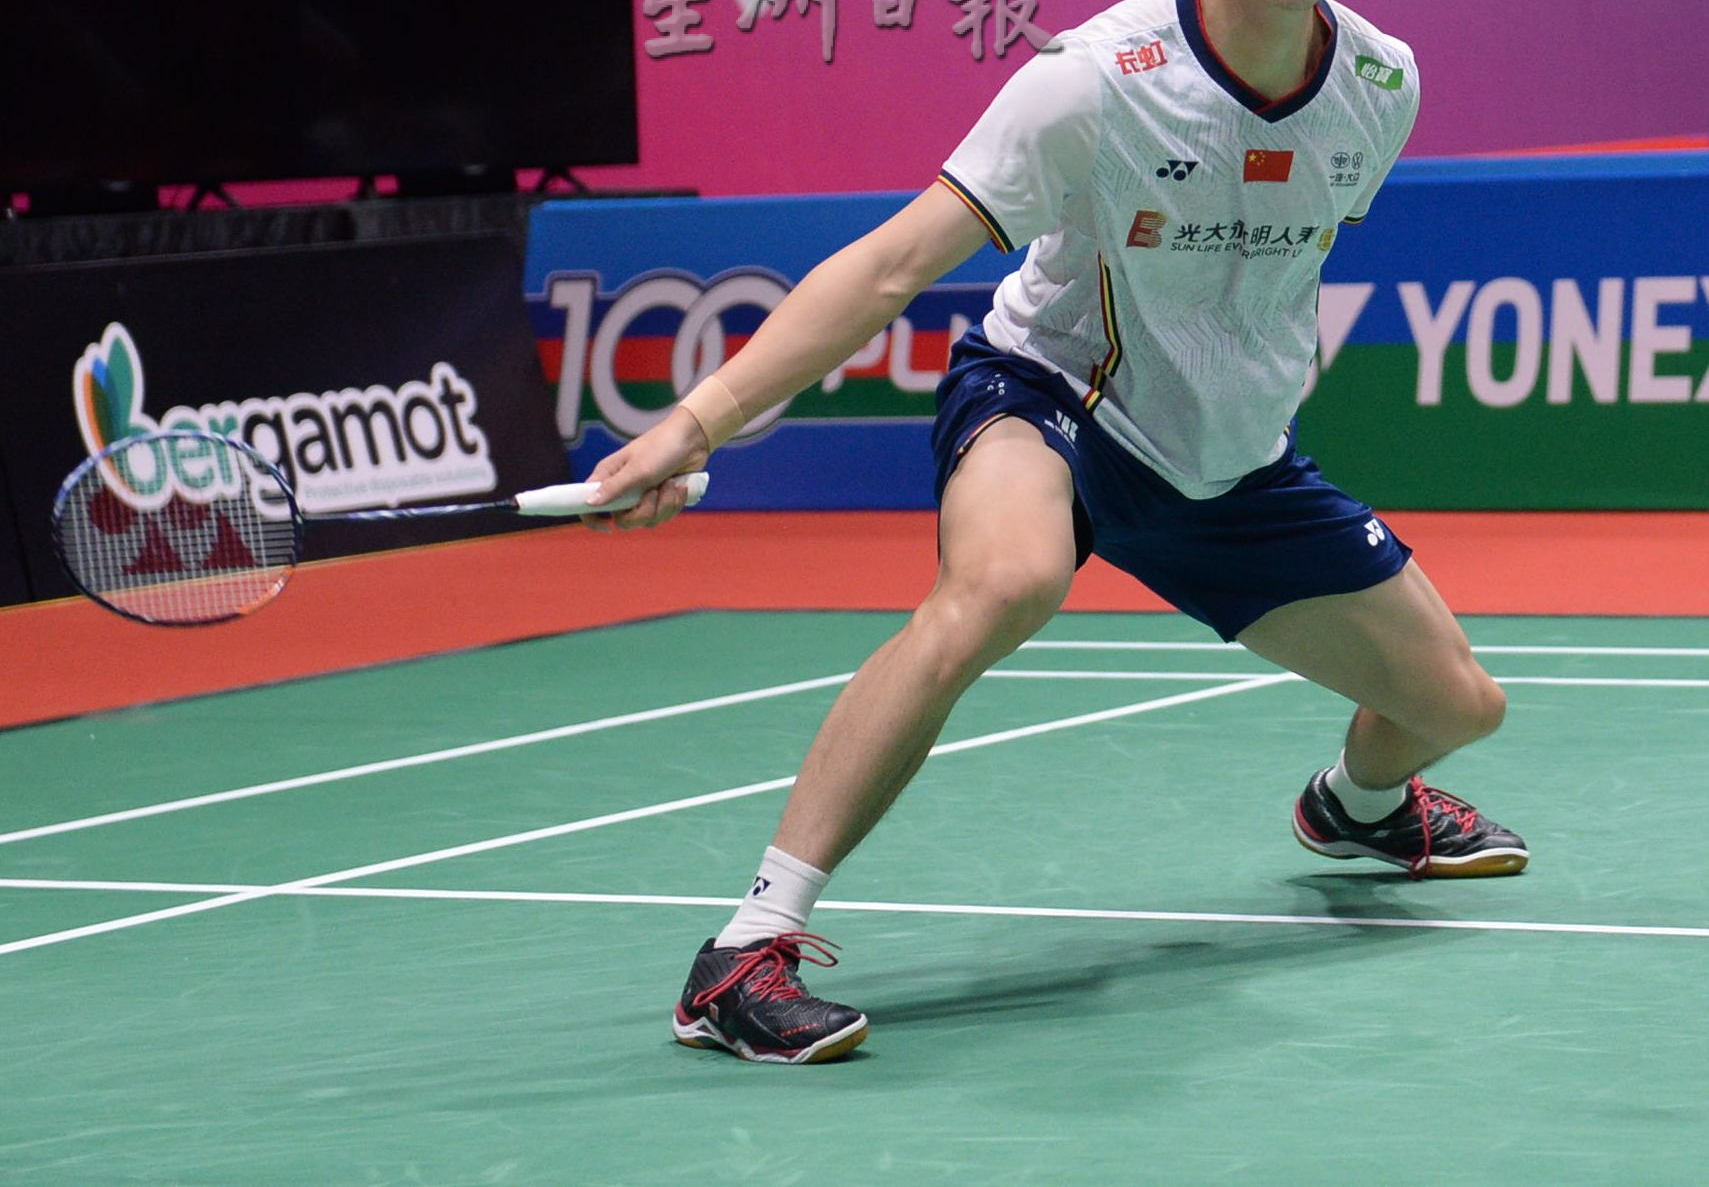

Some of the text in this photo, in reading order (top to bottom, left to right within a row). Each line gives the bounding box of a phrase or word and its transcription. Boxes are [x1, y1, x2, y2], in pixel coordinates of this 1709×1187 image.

[1170, 242, 1195, 252] SUN
[1197, 244, 1223, 253] LIFE
[1397, 276, 1709, 407] YONE
[82, 334, 479, 506] bergamot
